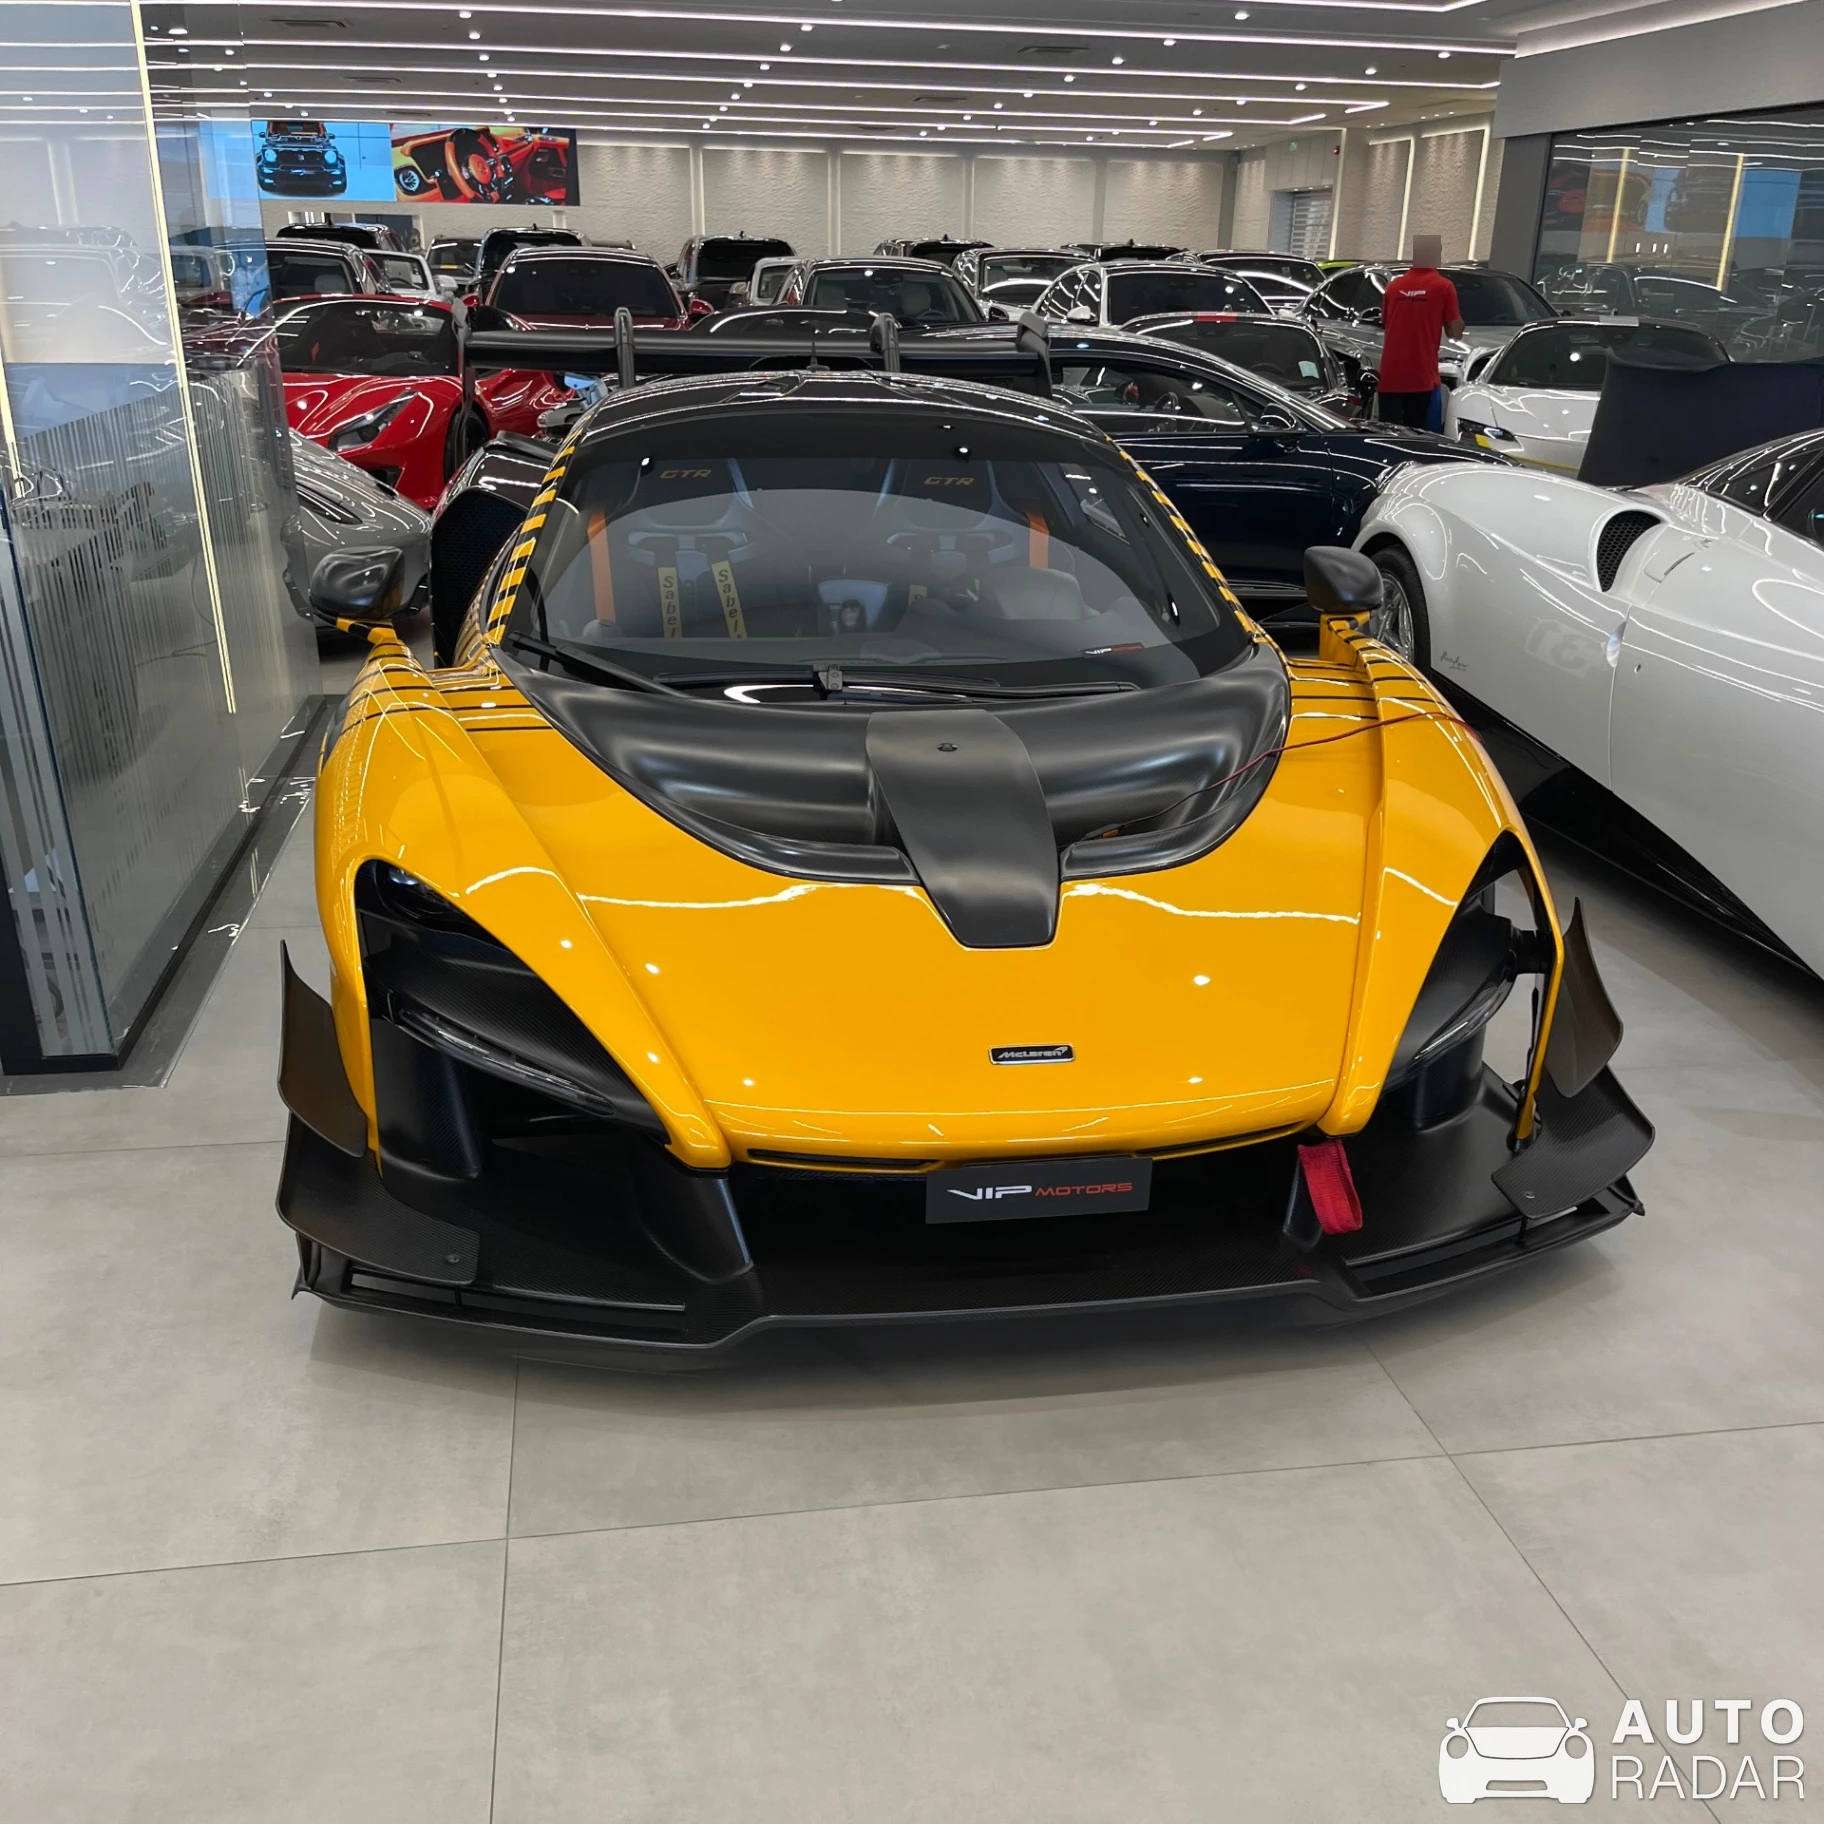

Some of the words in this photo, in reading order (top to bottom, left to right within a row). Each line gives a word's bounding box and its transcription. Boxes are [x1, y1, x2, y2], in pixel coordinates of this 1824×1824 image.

[660, 469, 712, 479] GTR
[924, 476, 974, 486] GTR
[718, 569, 743, 638] Sabel
[998, 1049, 1062, 1058] McLaren
[947, 1185, 1032, 1200] VIP
[1035, 1183, 1133, 1197] MOTORS
